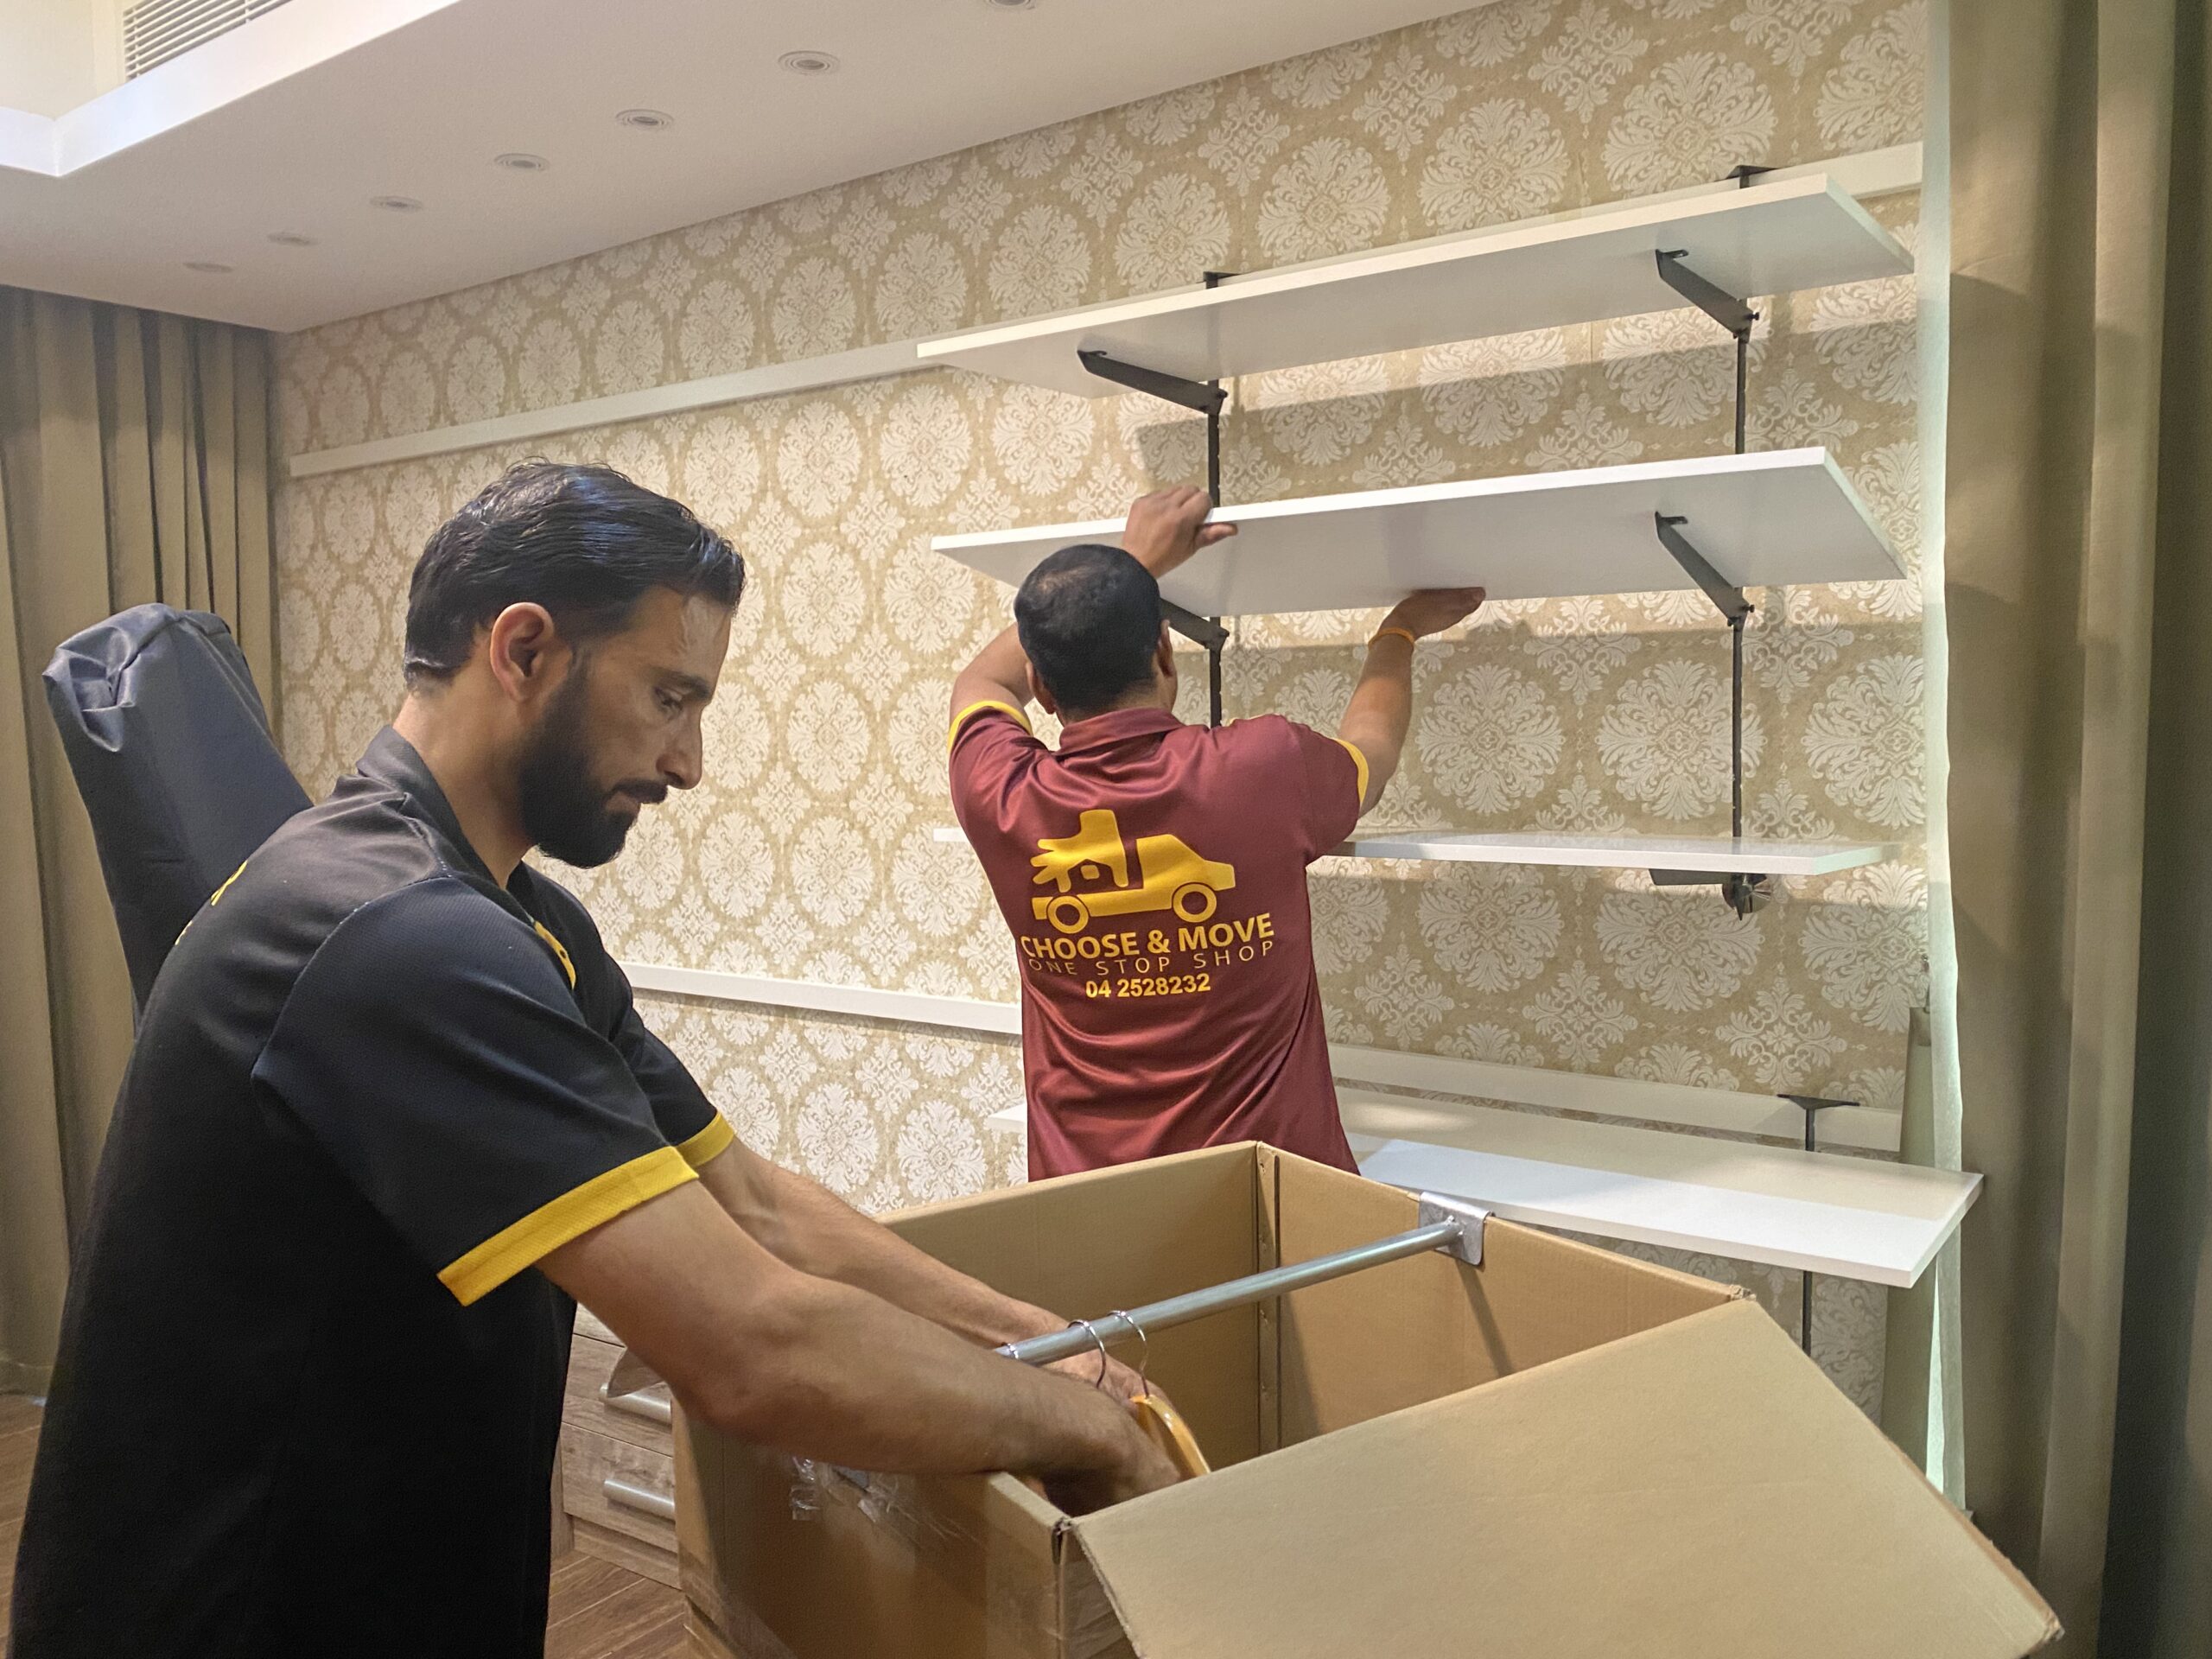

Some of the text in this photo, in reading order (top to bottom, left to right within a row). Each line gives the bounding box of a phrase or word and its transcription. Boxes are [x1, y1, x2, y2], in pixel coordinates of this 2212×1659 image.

[1020, 912, 1275, 960] CHOOSE & MOVE
[1028, 940, 1274, 976] ONE STOP SHOP
[1085, 973, 1211, 999] 04 2528232
